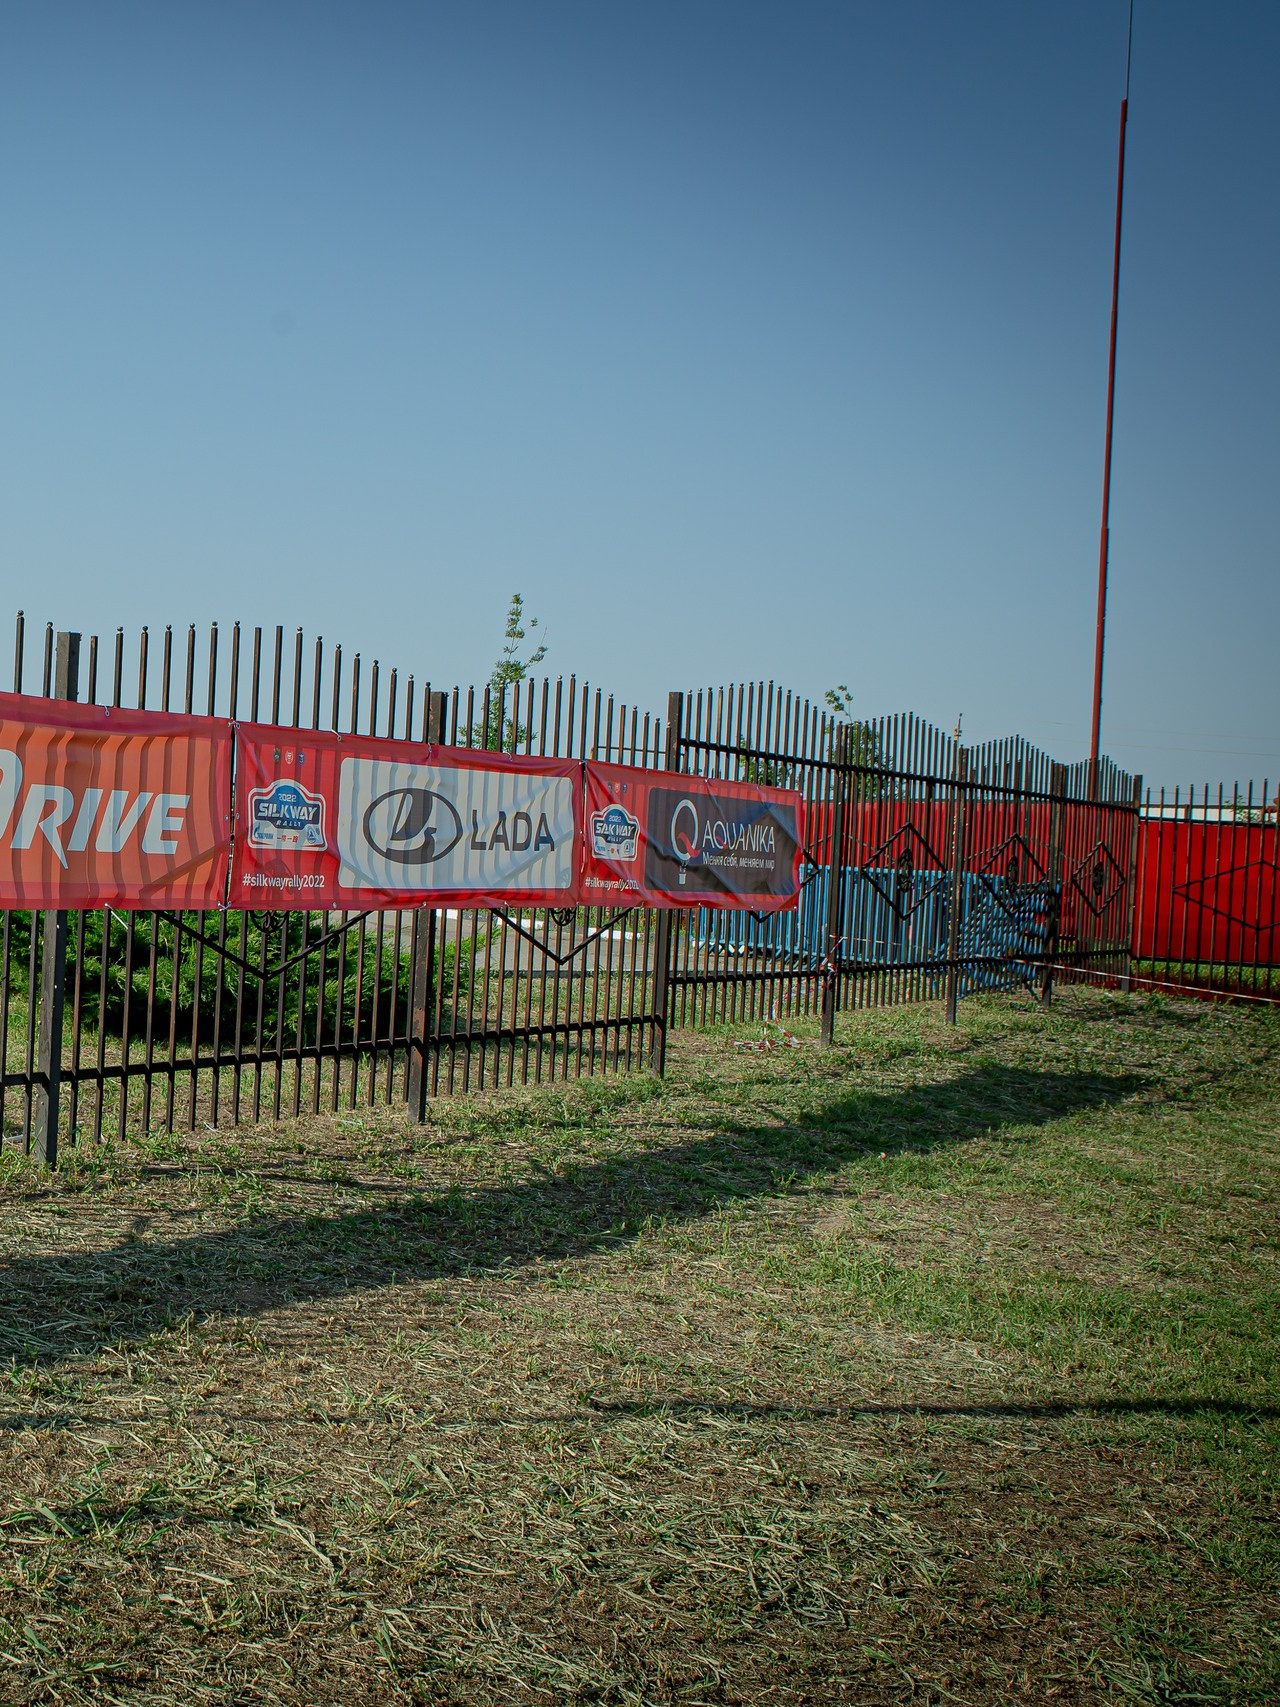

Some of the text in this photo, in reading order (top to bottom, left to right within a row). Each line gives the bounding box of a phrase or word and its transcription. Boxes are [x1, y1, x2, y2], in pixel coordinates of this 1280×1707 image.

[278, 793, 297, 802] 2022
[257, 803, 317, 821] SILK WAY
[471, 809, 555, 851] LADA
[702, 820, 776, 853] AQUANIKA
[242, 873, 325, 891] #silkwayrally2022
